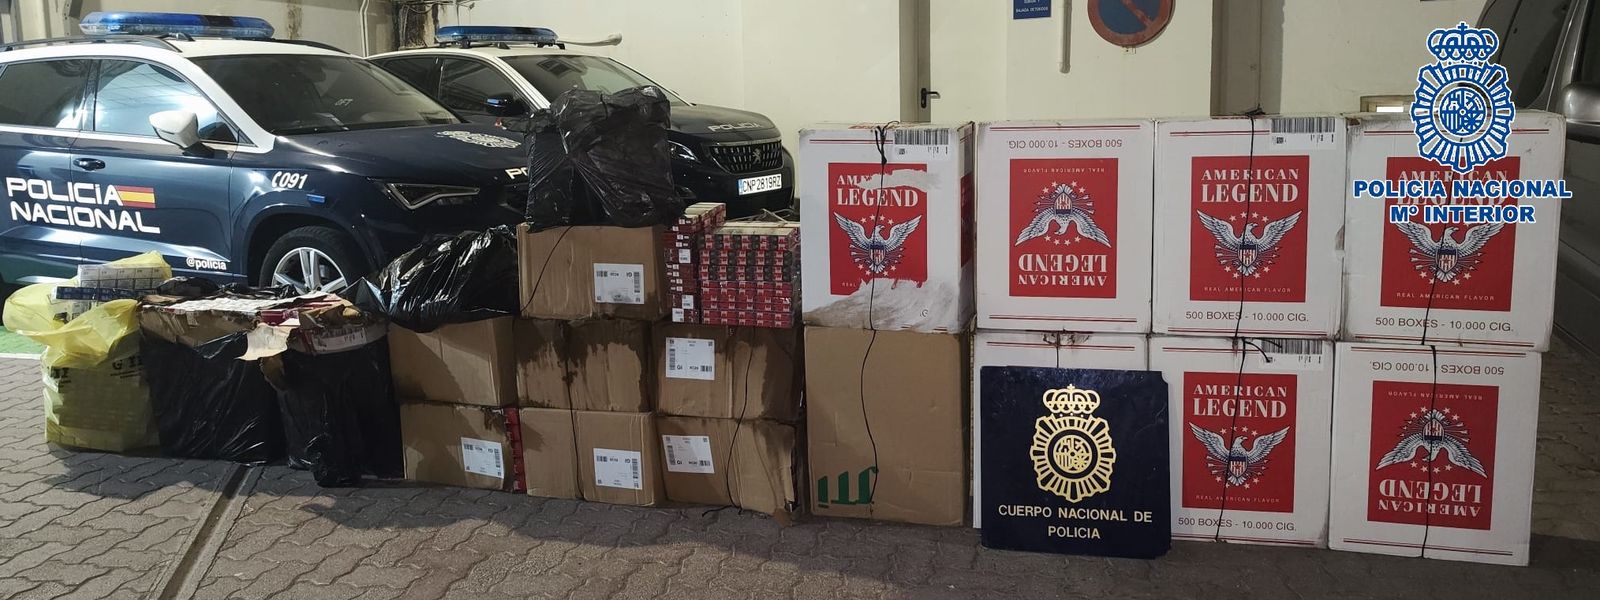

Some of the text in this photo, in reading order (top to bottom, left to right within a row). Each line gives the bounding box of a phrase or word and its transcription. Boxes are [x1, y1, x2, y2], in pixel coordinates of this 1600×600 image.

[1007, 140, 1027, 149] CIG.
[1029, 139, 1059, 149] 10.000
[1068, 139, 1102, 148] BOXES
[1105, 139, 1123, 148] 500
[279, 172, 308, 190] 091
[1201, 168, 1300, 181] AMERICAN
[837, 187, 919, 207] LEGEND
[1201, 182, 1299, 204] LEGEND
[10, 201, 160, 234] NACIONAL
[1018, 253, 1108, 273] LEGEND
[1018, 274, 1108, 287] AMERICAN
[1185, 311, 1204, 320] 500
[1206, 311, 1242, 320] BOXES
[1252, 312, 1285, 321] 10.000
[1287, 313, 1309, 322] CIG.
[1375, 317, 1395, 326] 500
[1398, 318, 1438, 328] BOXES
[1449, 321, 1486, 330] 10.000
[1489, 322, 1514, 332] CIG.
[1369, 361, 1505, 375] 500 BOXES 10.000 CIG.
[1193, 384, 1287, 398] AMERICAN
[1193, 398, 1287, 418] LEGEND
[1379, 479, 1482, 503] LEGEND
[998, 504, 1153, 523] CUERPO NACIONAL DE
[1378, 499, 1481, 518] AMERICAN
[1178, 517, 1196, 526] 500
[1198, 517, 1233, 528] BOXES
[1243, 520, 1273, 530] 10.000
[1276, 521, 1297, 532] CIG.
[1048, 526, 1101, 539] POLICIA
